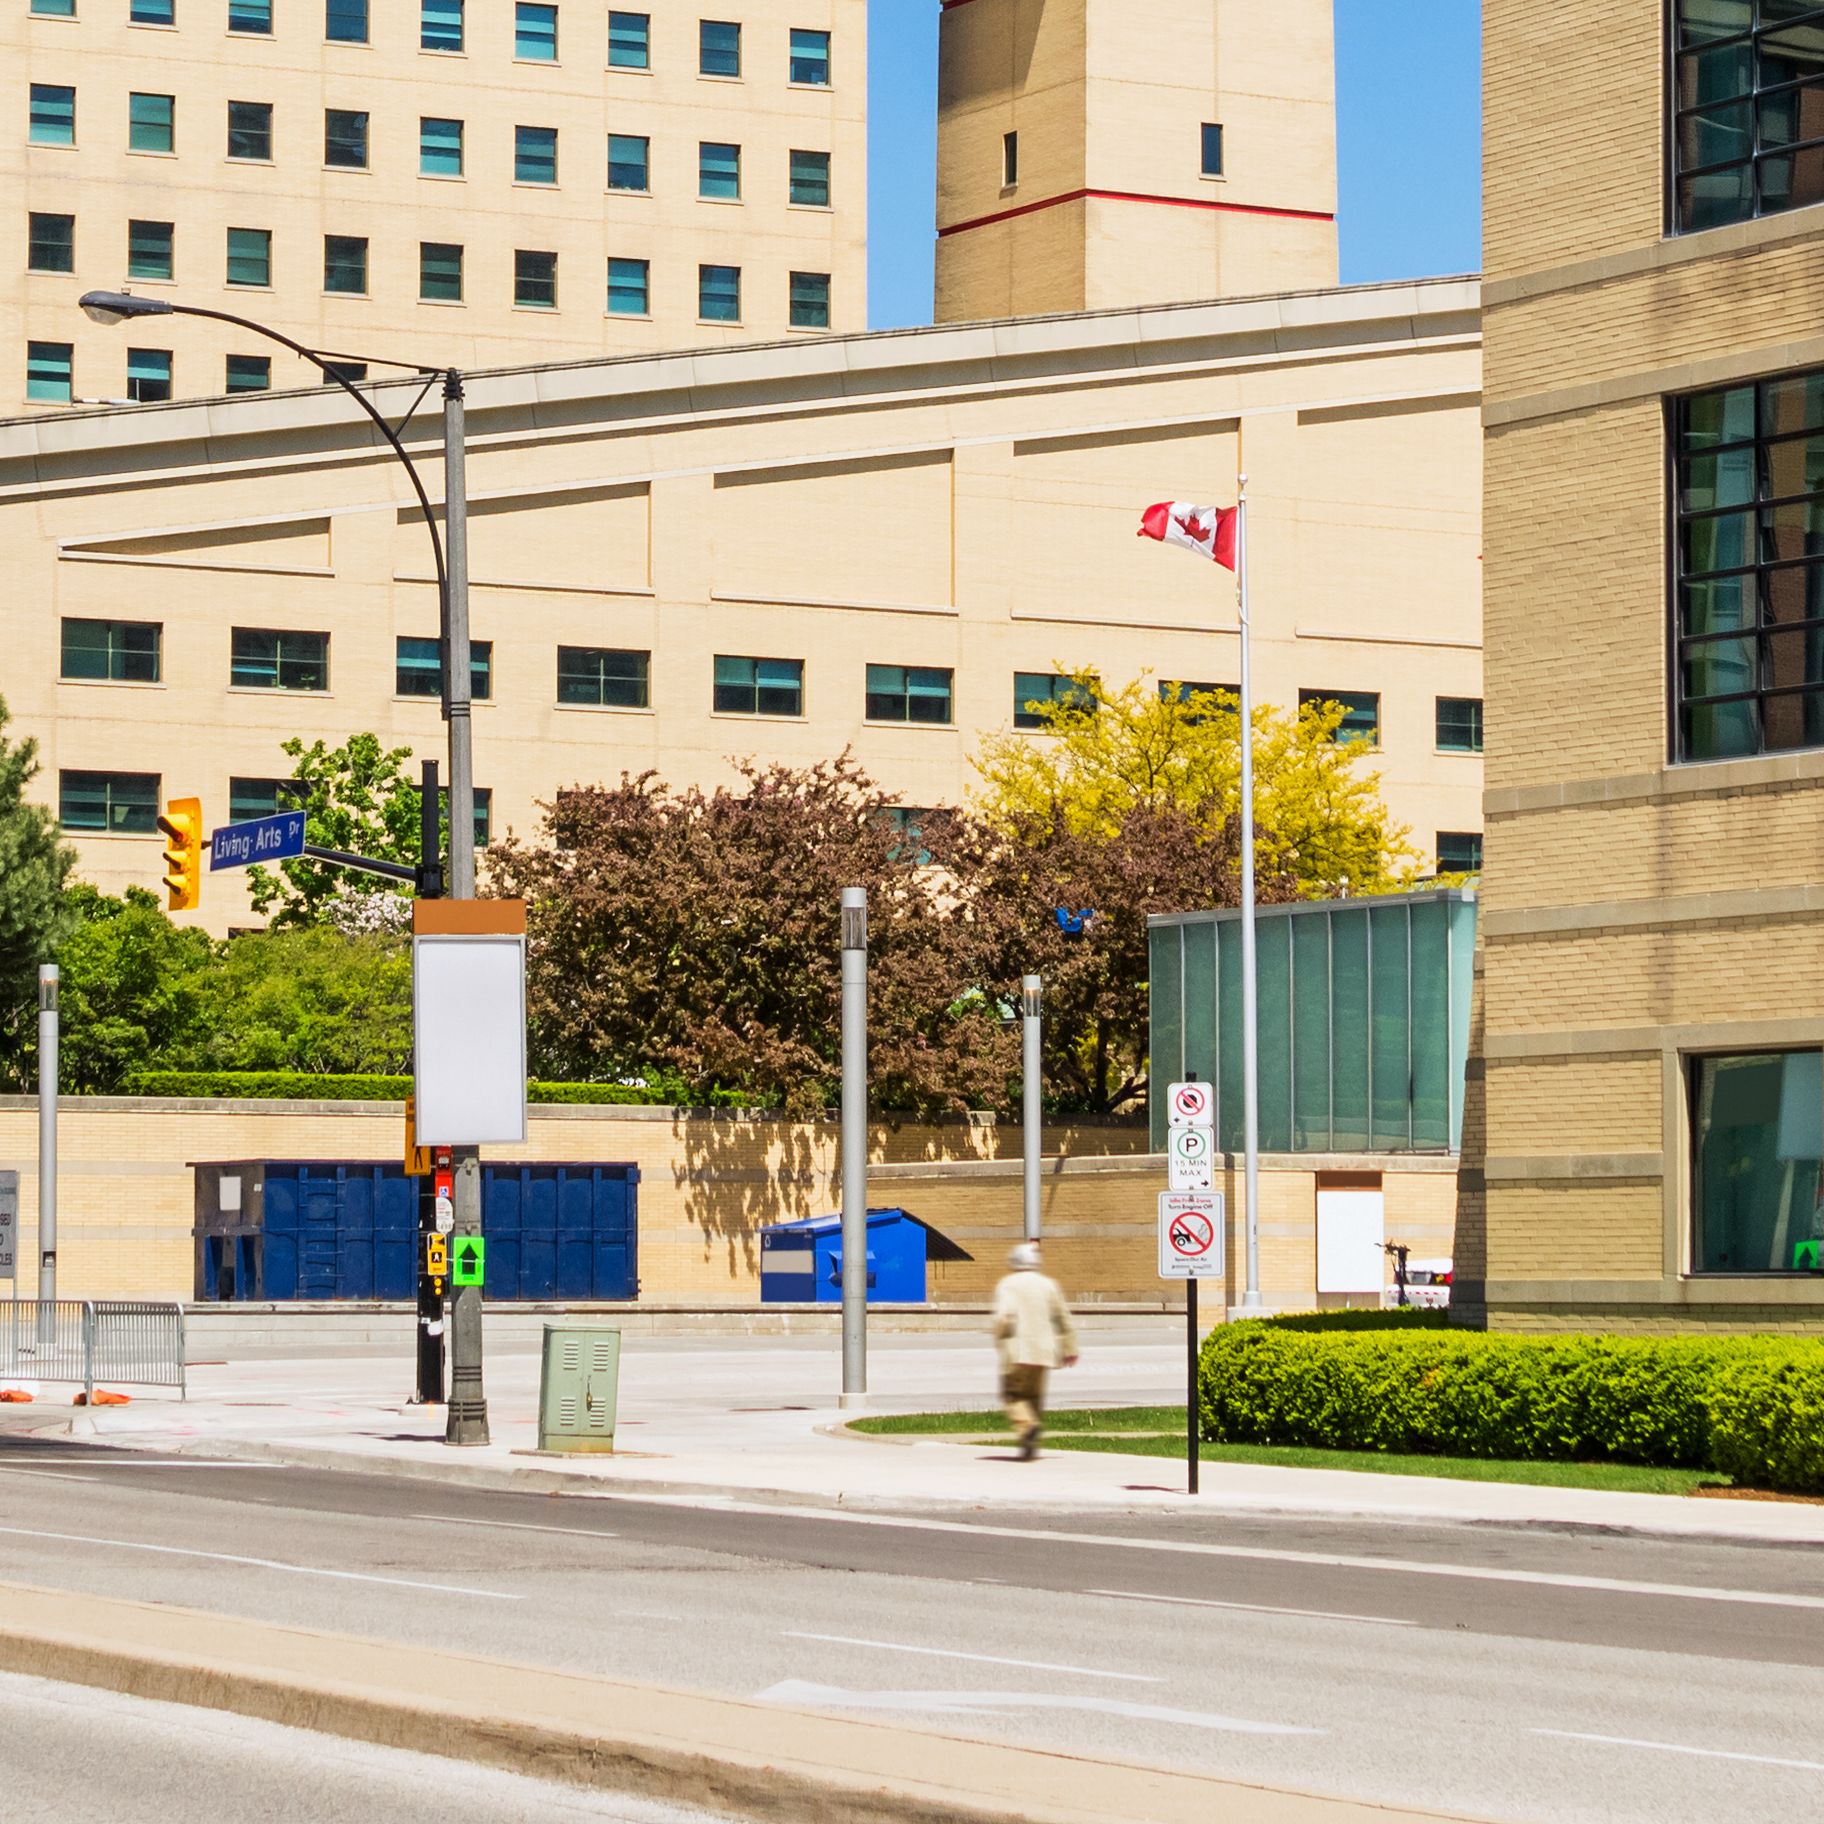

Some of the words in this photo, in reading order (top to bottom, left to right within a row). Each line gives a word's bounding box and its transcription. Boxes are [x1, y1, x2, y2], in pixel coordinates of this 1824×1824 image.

[214, 833, 250, 860] Living
[256, 826, 282, 850] Arts
[289, 821, 300, 836] Dr
[1186, 1138, 1198, 1152] P
